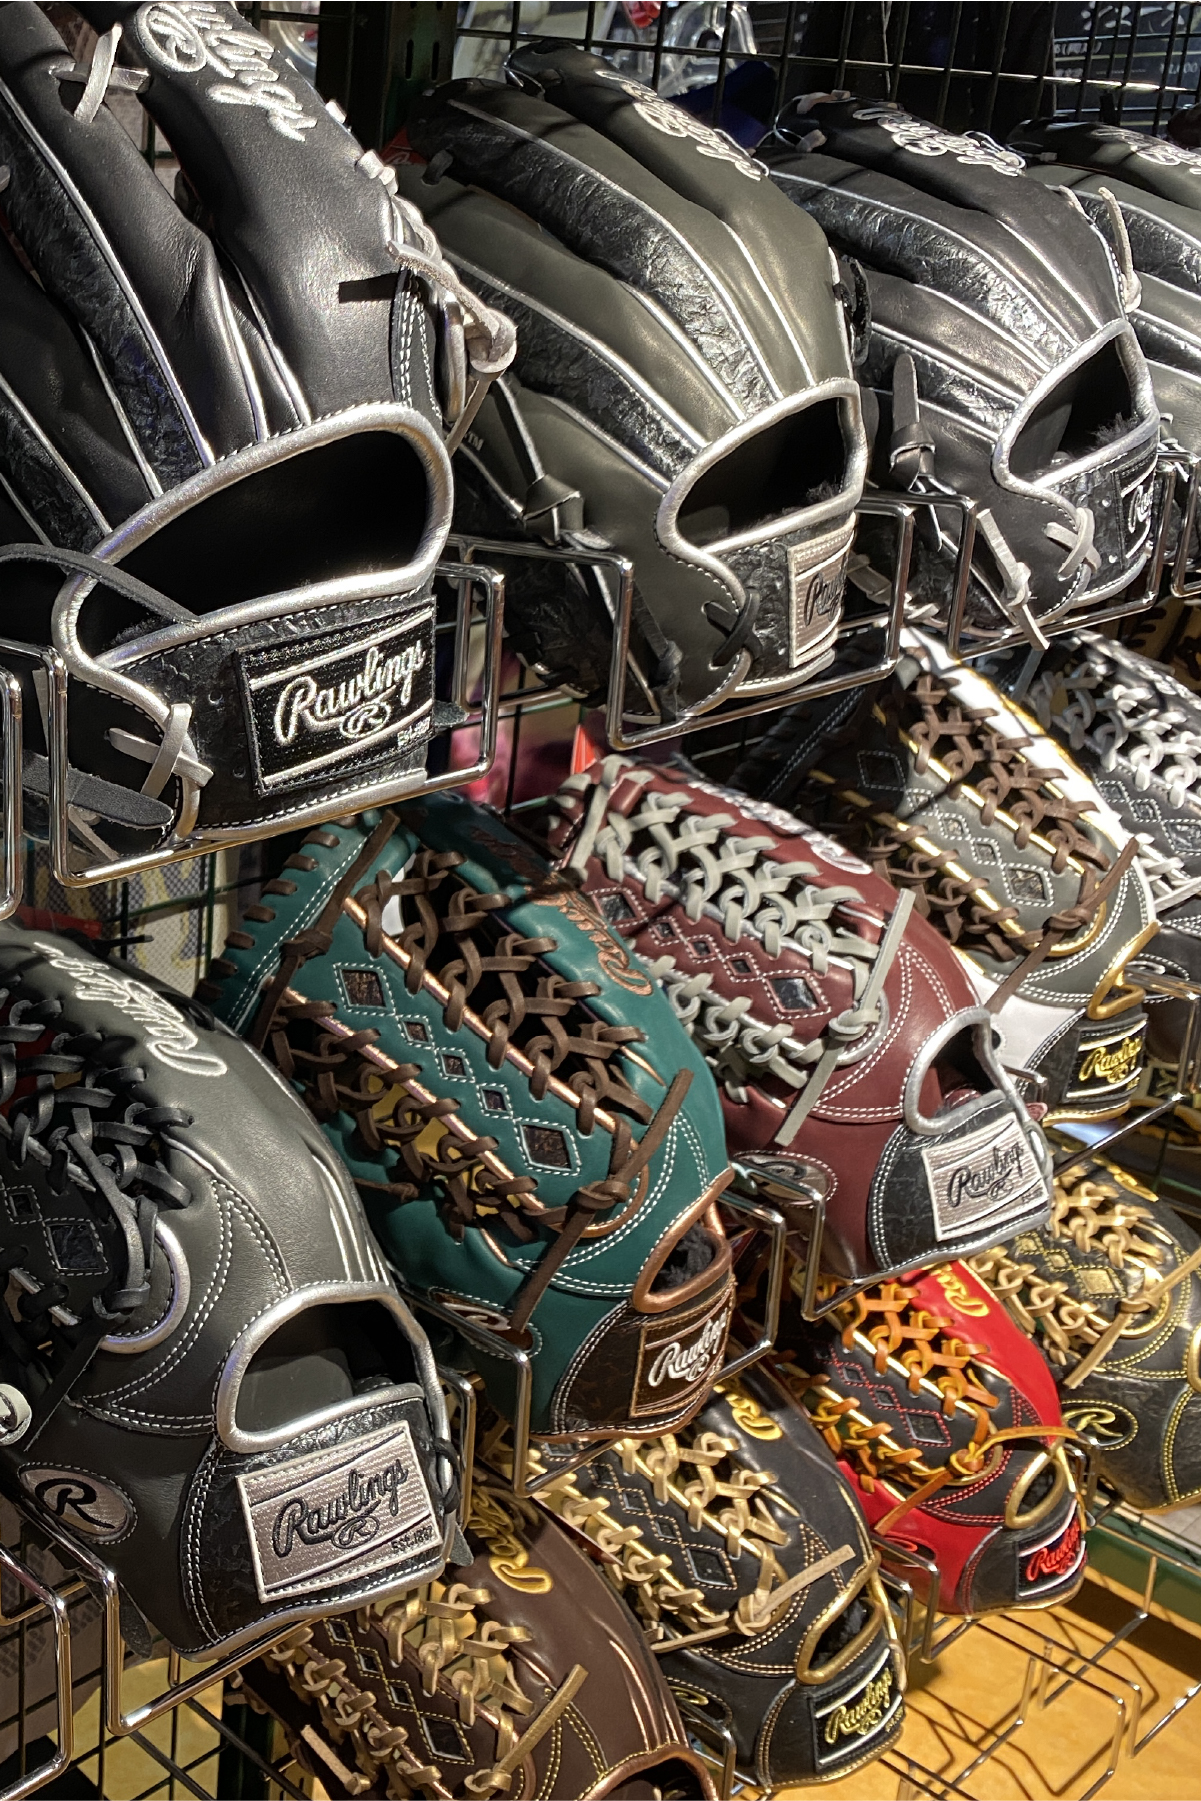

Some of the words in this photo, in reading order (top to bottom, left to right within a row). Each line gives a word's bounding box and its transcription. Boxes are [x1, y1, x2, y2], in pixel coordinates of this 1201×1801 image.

[175, 1, 318, 141] wlings
[274, 640, 427, 747] Rawlings
[34, 1478, 117, 1530] R
[272, 1458, 408, 1558] Rawlings
